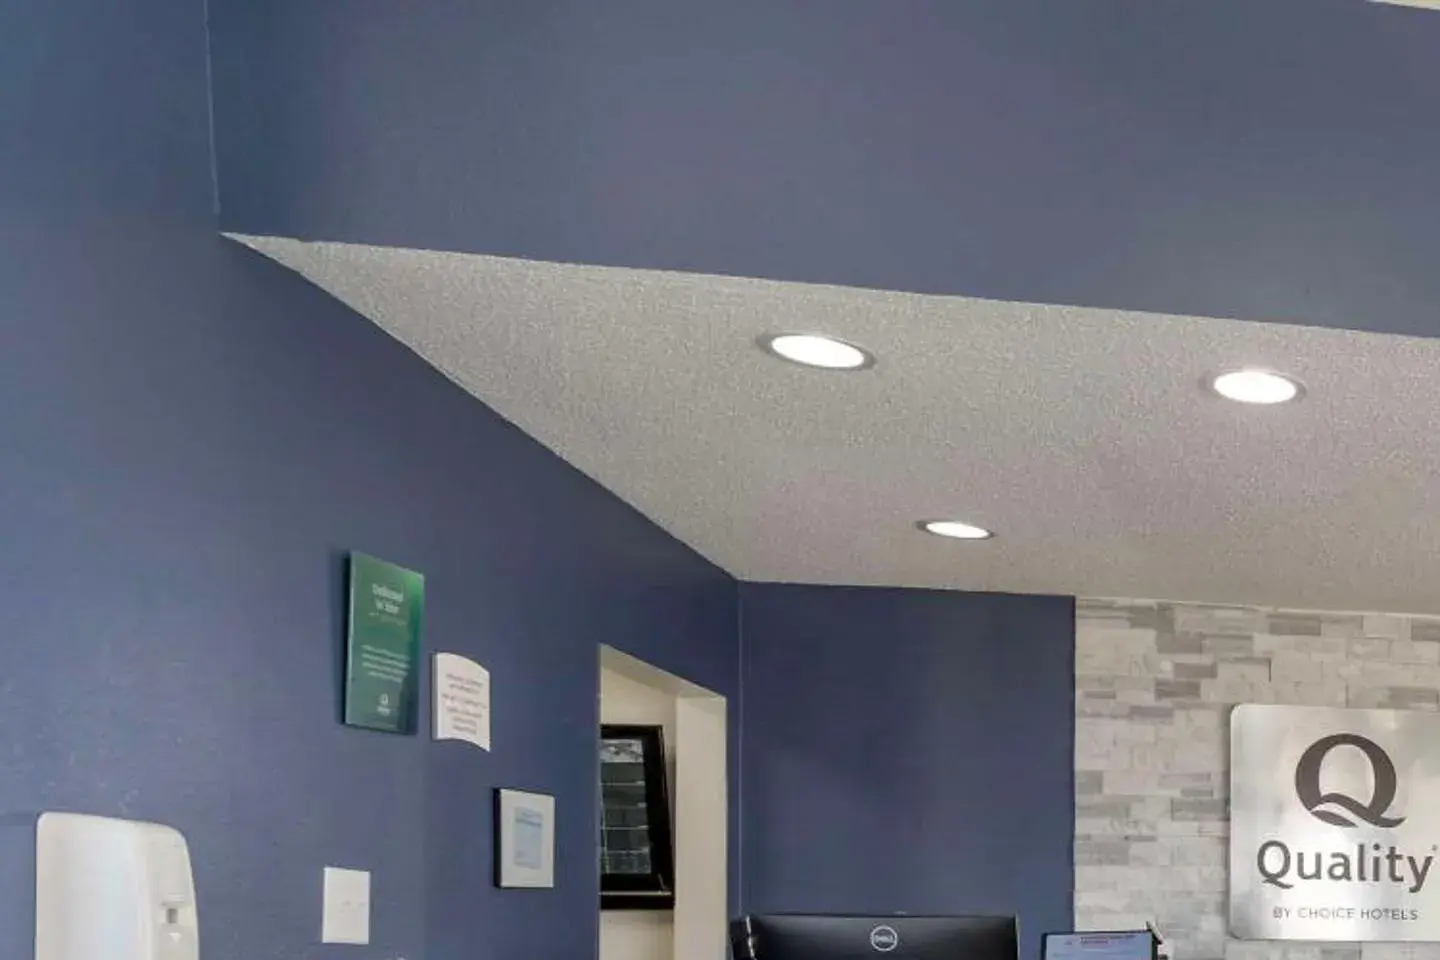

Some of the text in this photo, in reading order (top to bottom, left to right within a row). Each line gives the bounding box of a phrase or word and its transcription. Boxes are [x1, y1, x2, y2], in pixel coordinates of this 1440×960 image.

[1295, 733, 1407, 828] Q
[1257, 840, 1434, 893] Quality
[1273, 906, 1419, 921] BY CHOICE HOTELS
